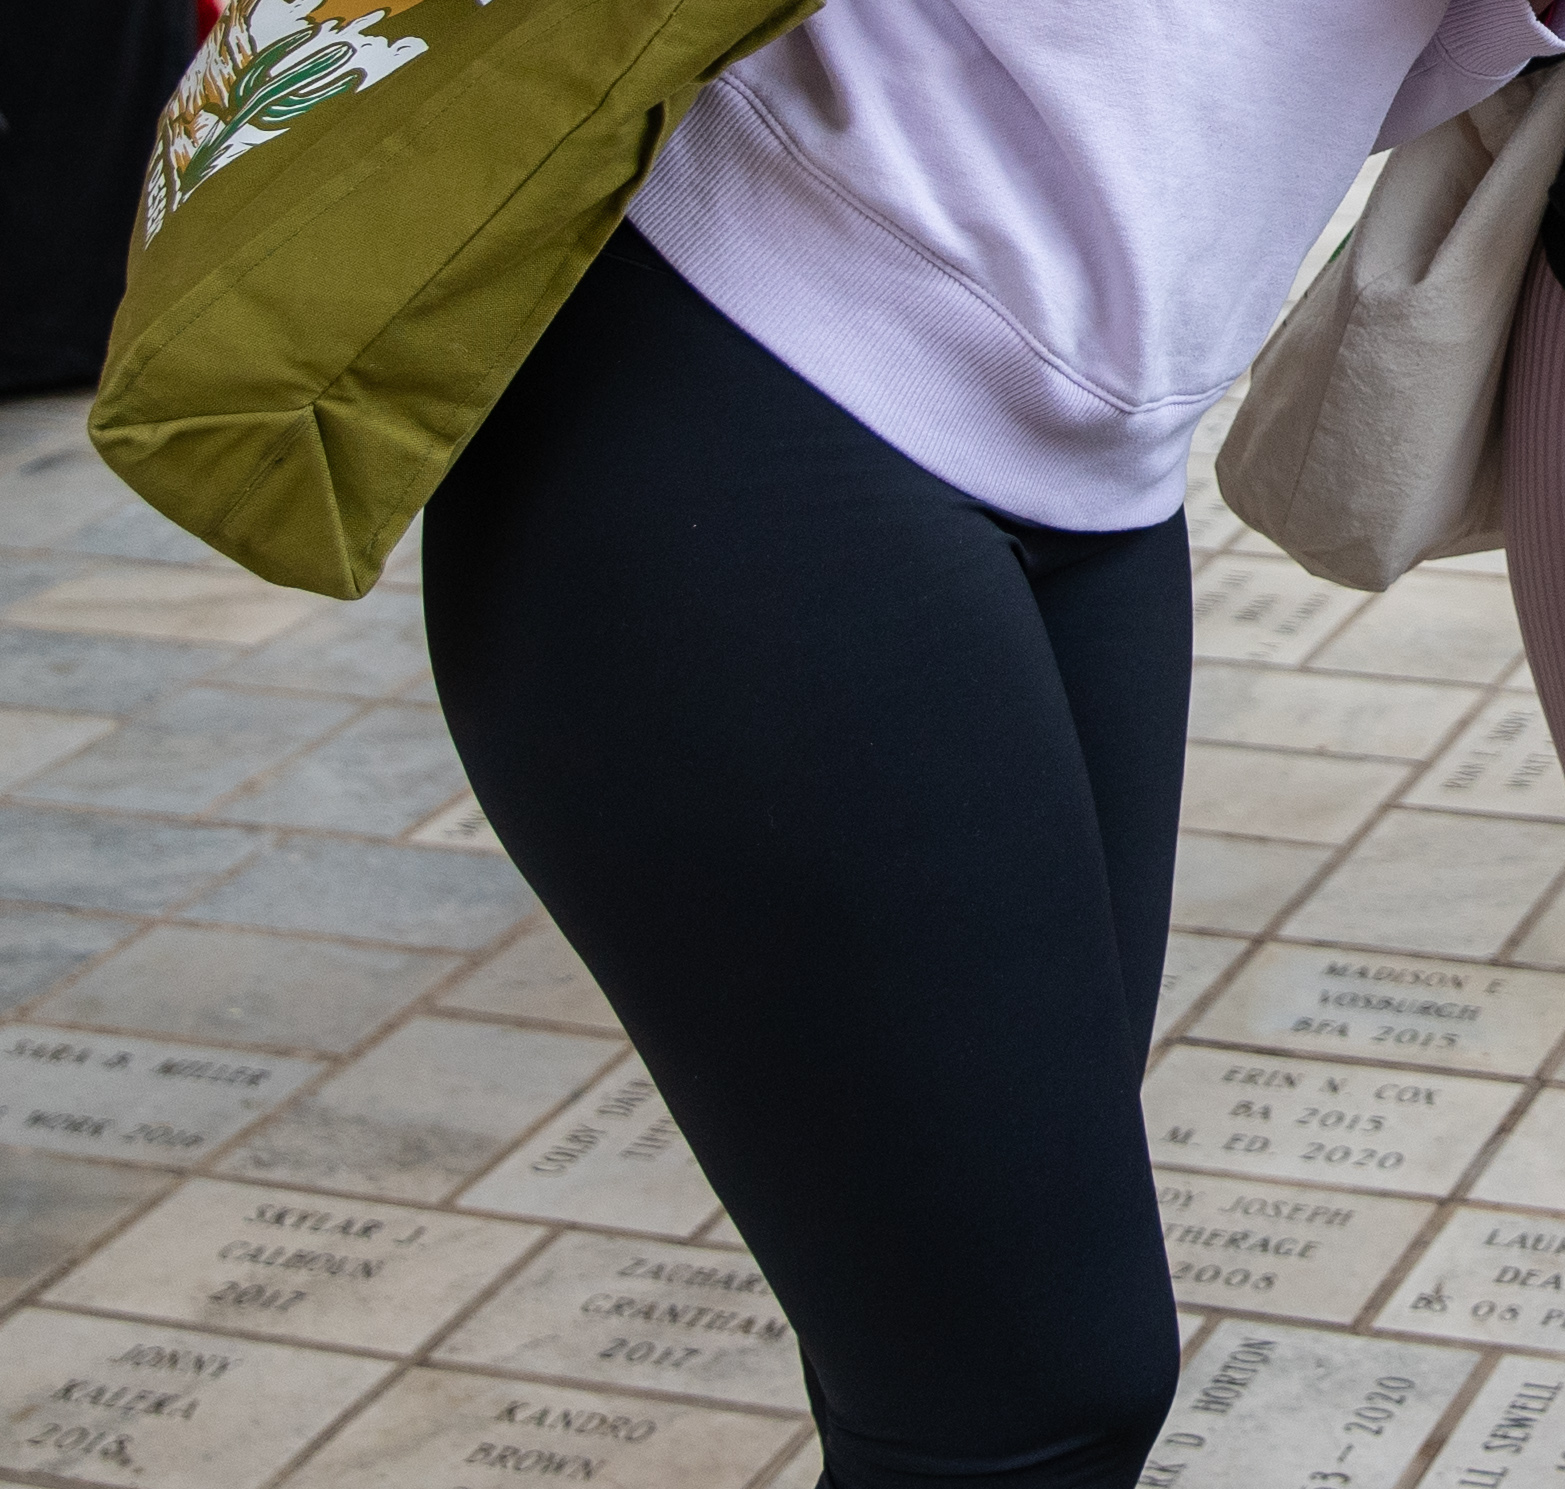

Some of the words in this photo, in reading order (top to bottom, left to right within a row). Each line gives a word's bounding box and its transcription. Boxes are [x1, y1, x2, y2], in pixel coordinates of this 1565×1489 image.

[1323, 961, 1470, 991] MADISON
[1290, 1016, 1350, 1038] BFA
[1371, 1025, 1461, 1049] 2015
[1221, 1065, 1304, 1089] ERIN
[1374, 1083, 1445, 1106] COX
[1230, 1099, 1273, 1122] BA
[1295, 1107, 1387, 1135] 2015
[1299, 1141, 1405, 1172] 2020
[1218, 1195, 1356, 1227] JOSEPH
[217, 1240, 386, 1279] CALHOUN
[1171, 1261, 1279, 1293] 2008
[581, 1293, 789, 1343] GRANTHAM
[600, 1336, 702, 1369] 2017
[1191, 1336, 1278, 1417] HORTON
[495, 1400, 658, 1444] KANDRO
[1343, 1374, 1417, 1438] 2020
[1484, 1379, 1565, 1454] SEWELL
[465, 1442, 603, 1482] BROWN
